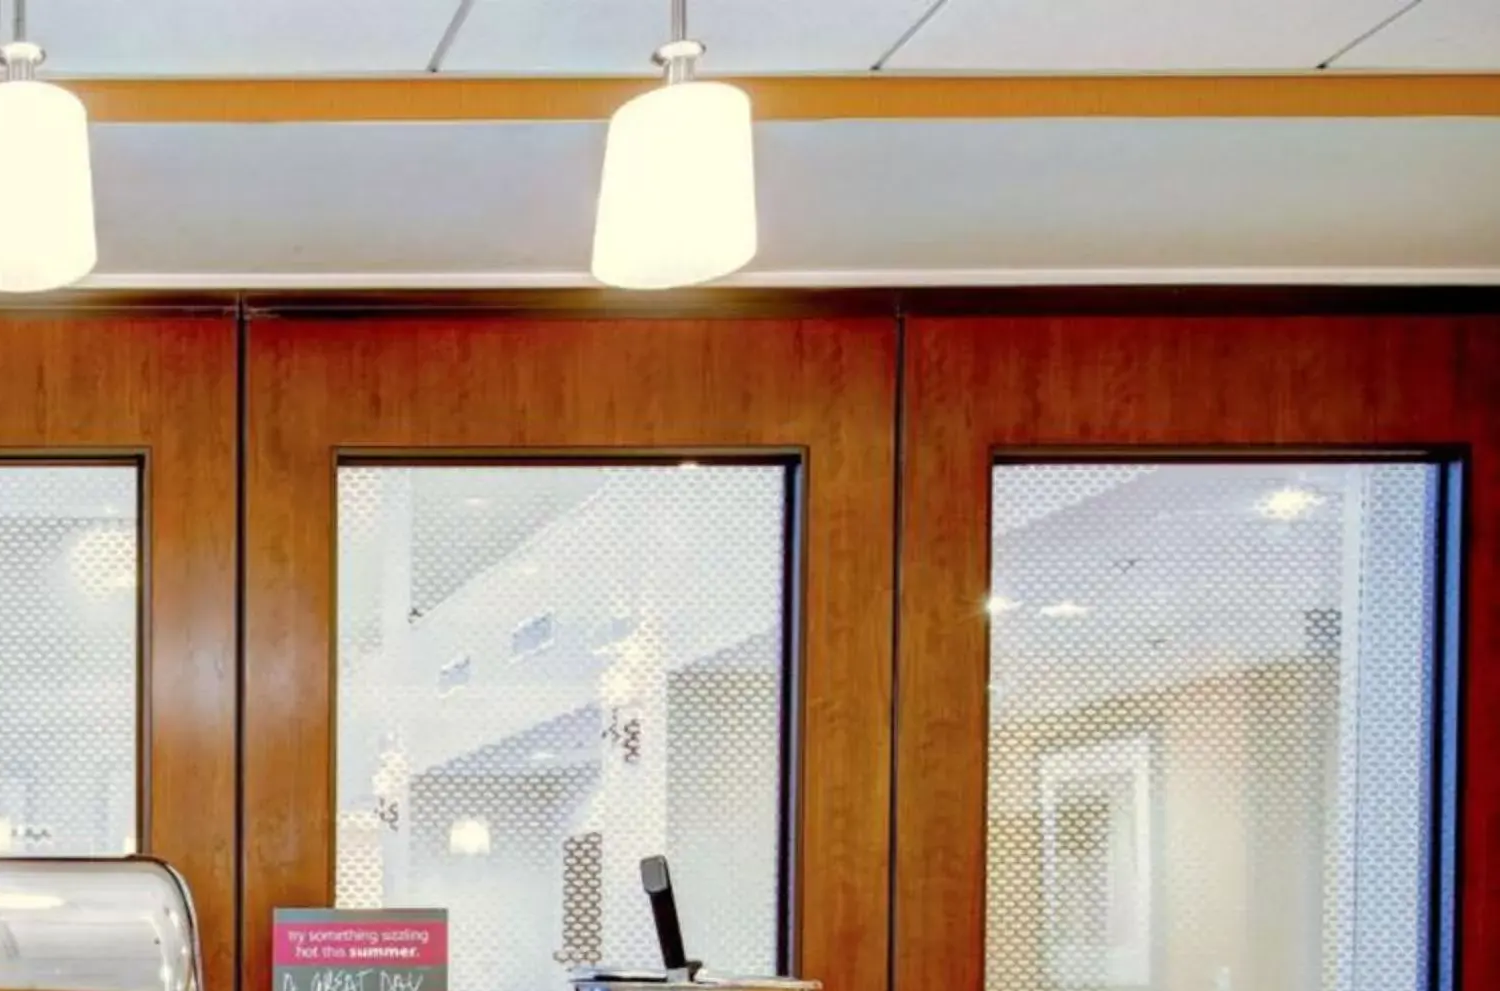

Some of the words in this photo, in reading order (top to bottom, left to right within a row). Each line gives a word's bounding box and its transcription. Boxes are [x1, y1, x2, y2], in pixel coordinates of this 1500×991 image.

[309, 928, 380, 944] something
[382, 928, 430, 945] sizzling
[296, 945, 319, 959] hot
[349, 946, 421, 959] summer.
